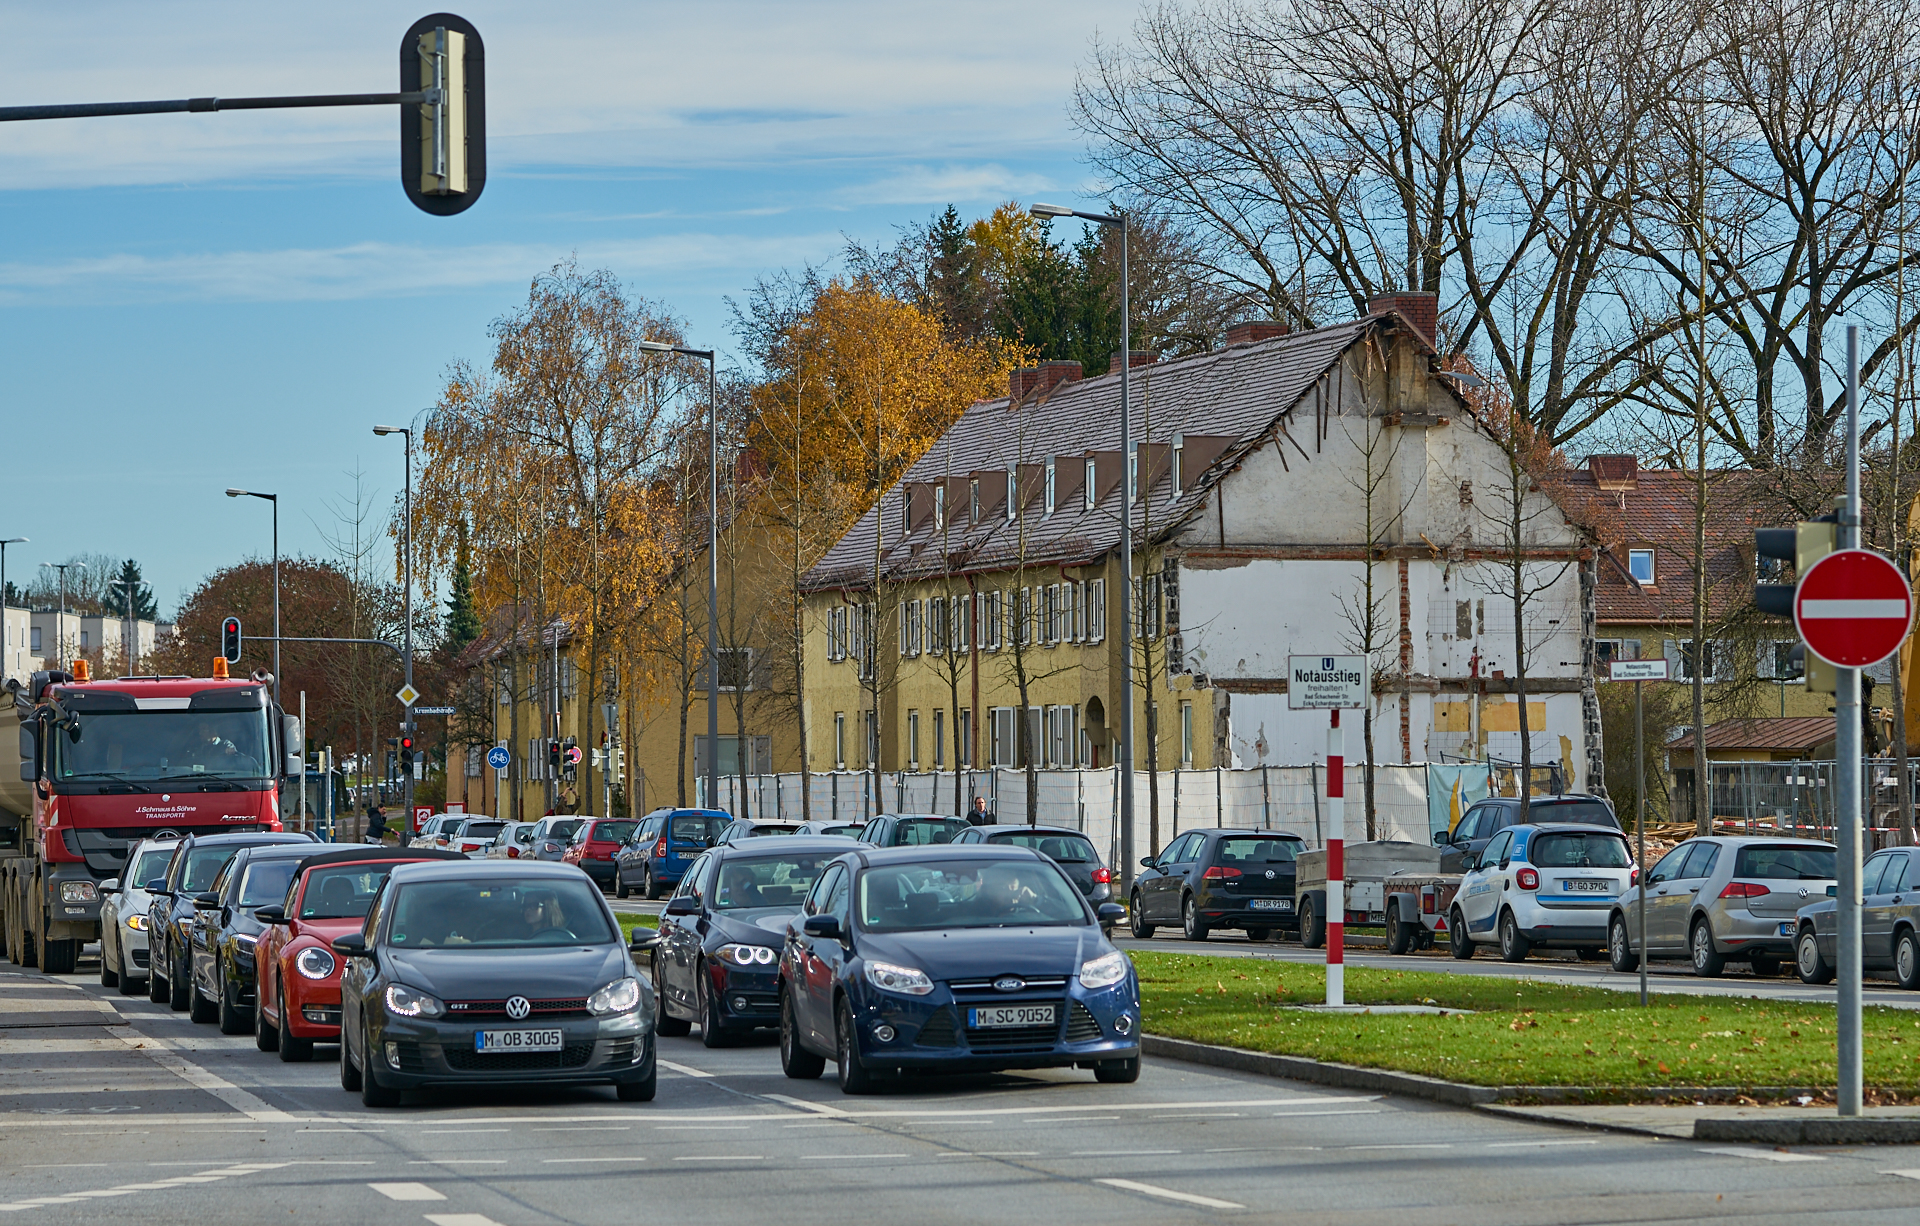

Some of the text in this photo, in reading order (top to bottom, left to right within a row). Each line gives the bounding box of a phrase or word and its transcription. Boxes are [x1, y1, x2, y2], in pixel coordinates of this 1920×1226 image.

[1295, 669, 1360, 686] Notausstieg
[1307, 684, 1343, 692] freihalten
[1589, 882, 1608, 890] 3704
[1273, 900, 1290, 908] 9178
[1000, 981, 1018, 989] Ford
[977, 1008, 1053, 1024] M SC 9052
[484, 1031, 560, 1047] M OB 3005
